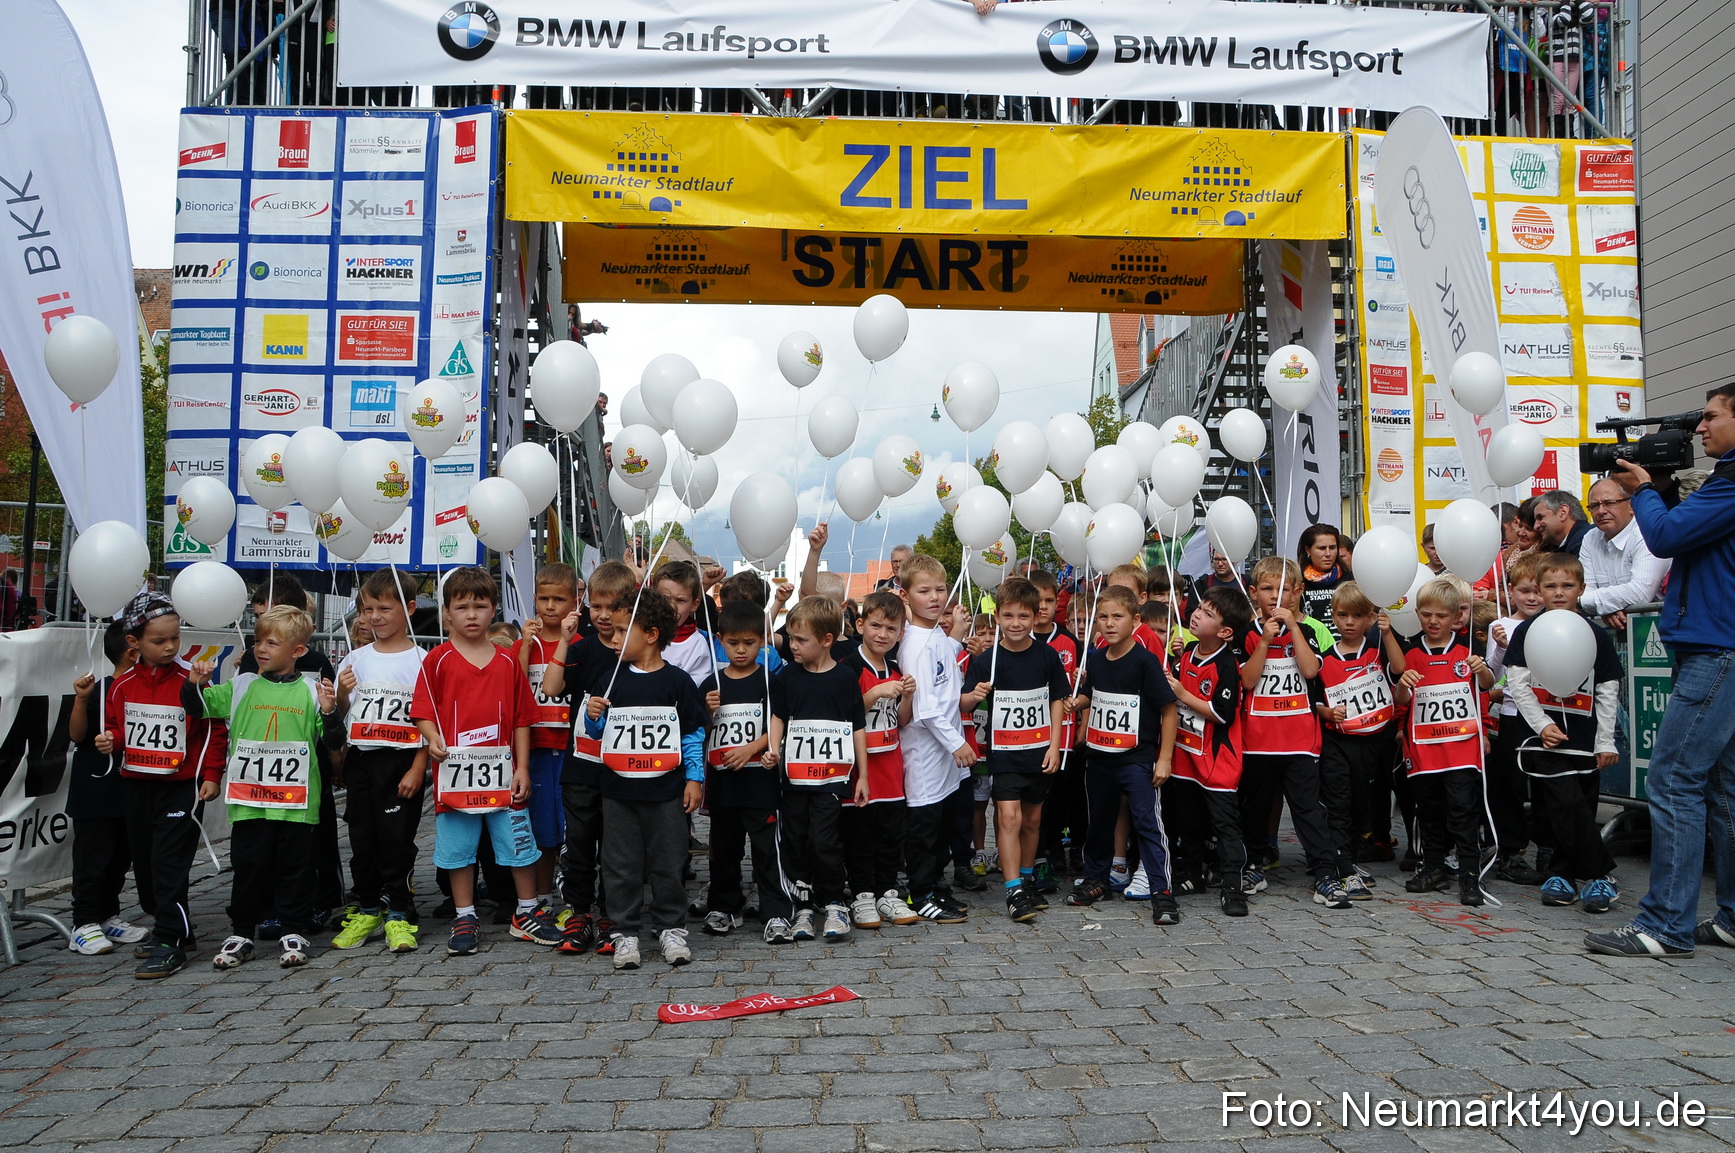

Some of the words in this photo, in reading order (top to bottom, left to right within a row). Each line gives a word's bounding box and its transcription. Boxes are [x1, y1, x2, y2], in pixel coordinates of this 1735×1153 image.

[446, 3, 497, 22] BMW
[1040, 19, 1093, 41] BMW
[515, 17, 626, 48] BMW
[637, 21, 830, 59] Laufsport
[1114, 34, 1217, 68] BMW
[1227, 37, 1403, 77] Laufsport
[190, 148, 214, 160] DEHN
[278, 146, 307, 159] Braun
[455, 145, 475, 156] Braun
[1512, 148, 1544, 170] RUND
[1586, 153, 1605, 163] GUT
[1605, 152, 1622, 163] FÜR
[551, 171, 651, 190] Neumarkter
[655, 176, 734, 192] Stadtlauf
[840, 143, 1028, 210] ZIEL
[1512, 170, 1549, 189] SCHAU
[1129, 187, 1225, 203] Neumarkter
[1229, 189, 1304, 204] Stadtlauf
[185, 201, 234, 211] Bionorica
[262, 200, 290, 210] Audi
[291, 201, 317, 210] BKK
[347, 199, 416, 219] Xplus1
[1511, 225, 1555, 235] WITTMANN
[1606, 236, 1627, 248] DEHN
[445, 247, 477, 256] Lammsbräu
[356, 258, 414, 267] INTERSPORT
[792, 235, 1029, 292] START
[274, 267, 322, 278] Bionorica
[346, 268, 414, 279] HACKNER
[600, 262, 682, 275] Neumarkter
[687, 263, 751, 276] Stadtlauf
[1067, 271, 1146, 286] Neumarkter
[1149, 272, 1208, 288] Stadtlauf
[1435, 264, 1467, 353] BKK
[347, 320, 367, 329] GUT
[368, 318, 387, 329] FÜR
[388, 321, 408, 330] SIE!
[200, 331, 227, 340] Tagblatt
[266, 345, 304, 355] KANN
[1369, 339, 1407, 350] NATHUS
[244, 394, 289, 402] GERHART
[355, 385, 392, 404] maxi
[265, 402, 295, 410] JANIG
[1376, 408, 1411, 416] INTERSPORT
[375, 413, 390, 424] dsl
[1371, 415, 1411, 425] HACKNER
[1531, 476, 1557, 488] Braun
[251, 537, 303, 546] Neumarkter
[241, 546, 311, 558] Lammsbräu
[1260, 672, 1303, 695] 7248
[1348, 678, 1376, 693] Neumarkt
[1429, 688, 1461, 698] Neumarkt
[995, 696, 1015, 704] PARTL
[1016, 696, 1043, 704] Neumarkt
[1099, 698, 1128, 707] Neumarkt
[1273, 699, 1292, 709] Erik
[254, 704, 289, 713] Goldhutlauf
[290, 707, 304, 715] 2012
[720, 710, 752, 719] Neumarkt
[1417, 697, 1469, 723] 7263
[140, 711, 176, 721] Neumarkt
[609, 714, 630, 723] PARTL
[630, 714, 667, 722] Neumarkt
[1000, 704, 1046, 730] 7381
[1091, 705, 1131, 732] 7164
[1360, 713, 1379, 727] Max
[126, 721, 178, 750] 7243
[360, 726, 409, 741] Christoph
[469, 730, 488, 742] DEHN
[809, 727, 841, 735] Neumarkt
[1430, 726, 1460, 737] Julius
[612, 724, 671, 751] 7152
[1096, 733, 1115, 745] Leon
[237, 746, 256, 756] PARTL
[258, 747, 297, 756] Neumarkt
[792, 736, 844, 761] 7141
[237, 756, 300, 783] 7142
[628, 757, 653, 770] Paul
[447, 762, 504, 788] 7131
[807, 765, 829, 778] Felix
[250, 787, 285, 801] Niklas
[466, 794, 488, 806] Luis
